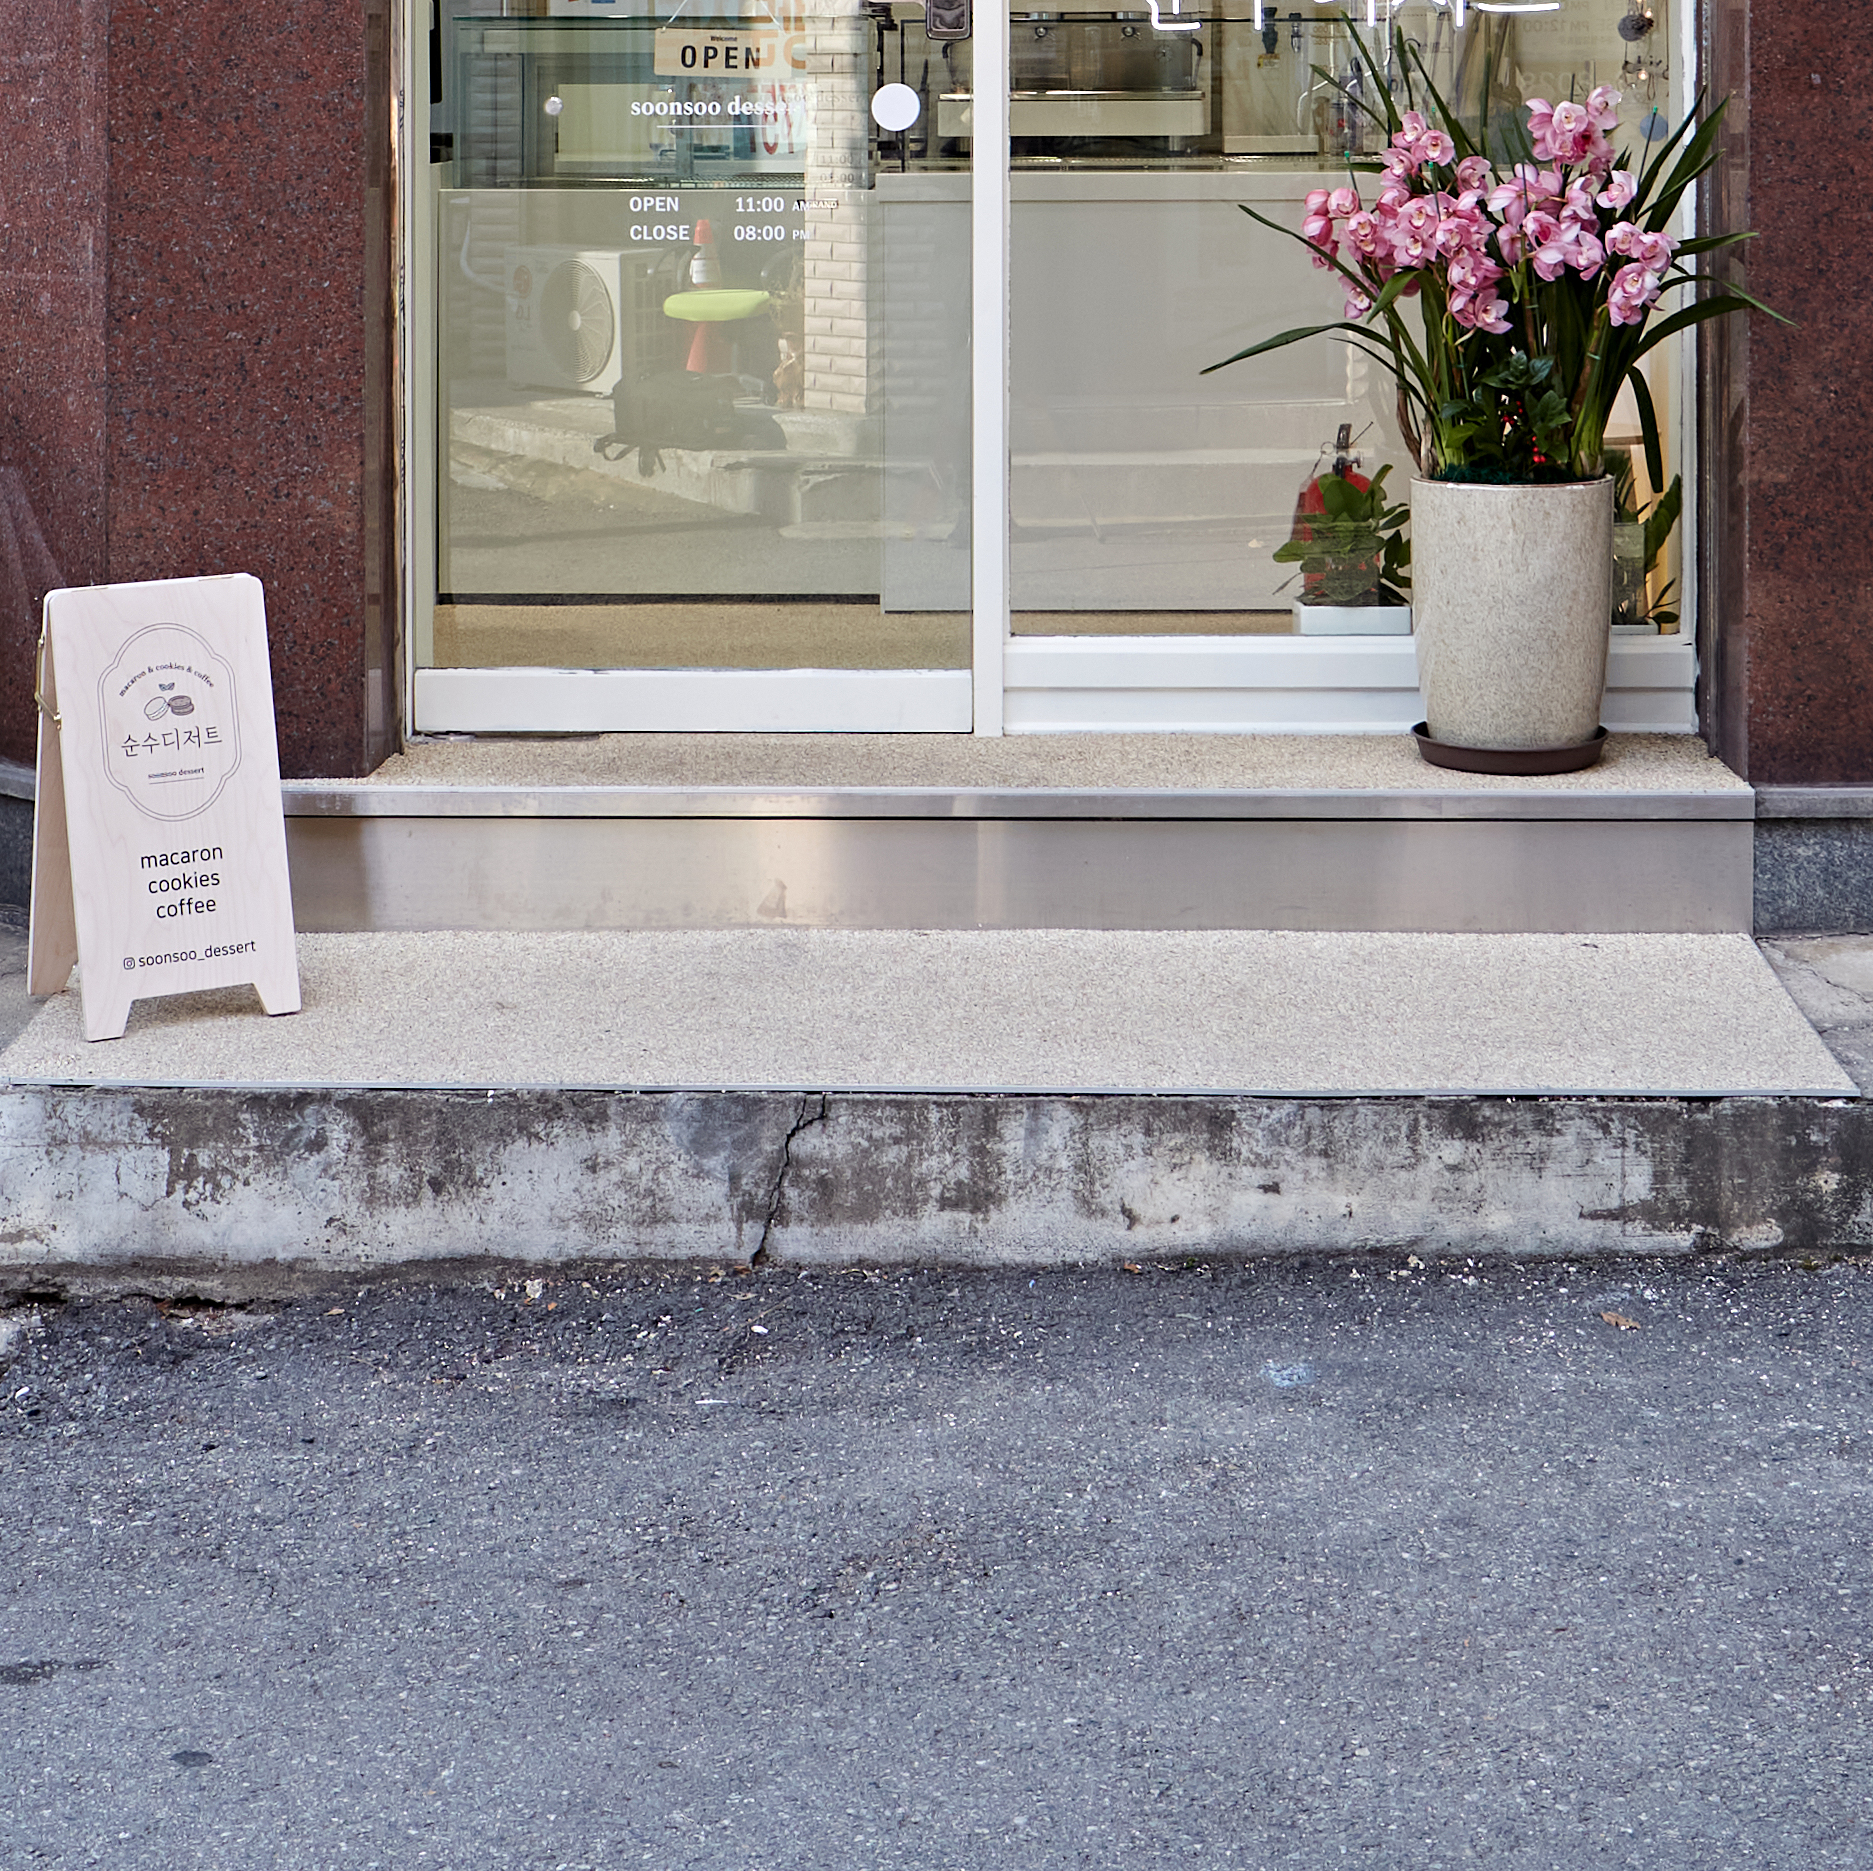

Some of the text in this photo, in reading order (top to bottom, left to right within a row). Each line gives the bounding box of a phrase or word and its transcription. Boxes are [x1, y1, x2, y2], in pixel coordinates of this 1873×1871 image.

[680, 44, 761, 70] OPEN
[630, 100, 722, 116] soonsoo
[629, 196, 680, 213] OPEN
[735, 196, 785, 213] 11:00
[629, 224, 691, 241] CLOSE
[733, 224, 786, 241] 08:00
[119, 670, 147, 697] macaron
[155, 661, 185, 671] cookies
[121, 725, 223, 757] 순수디저트
[140, 843, 224, 870] macaron
[147, 870, 221, 895] cookies
[155, 897, 217, 920] coffee
[137, 940, 257, 969] soonsoo_dessert
